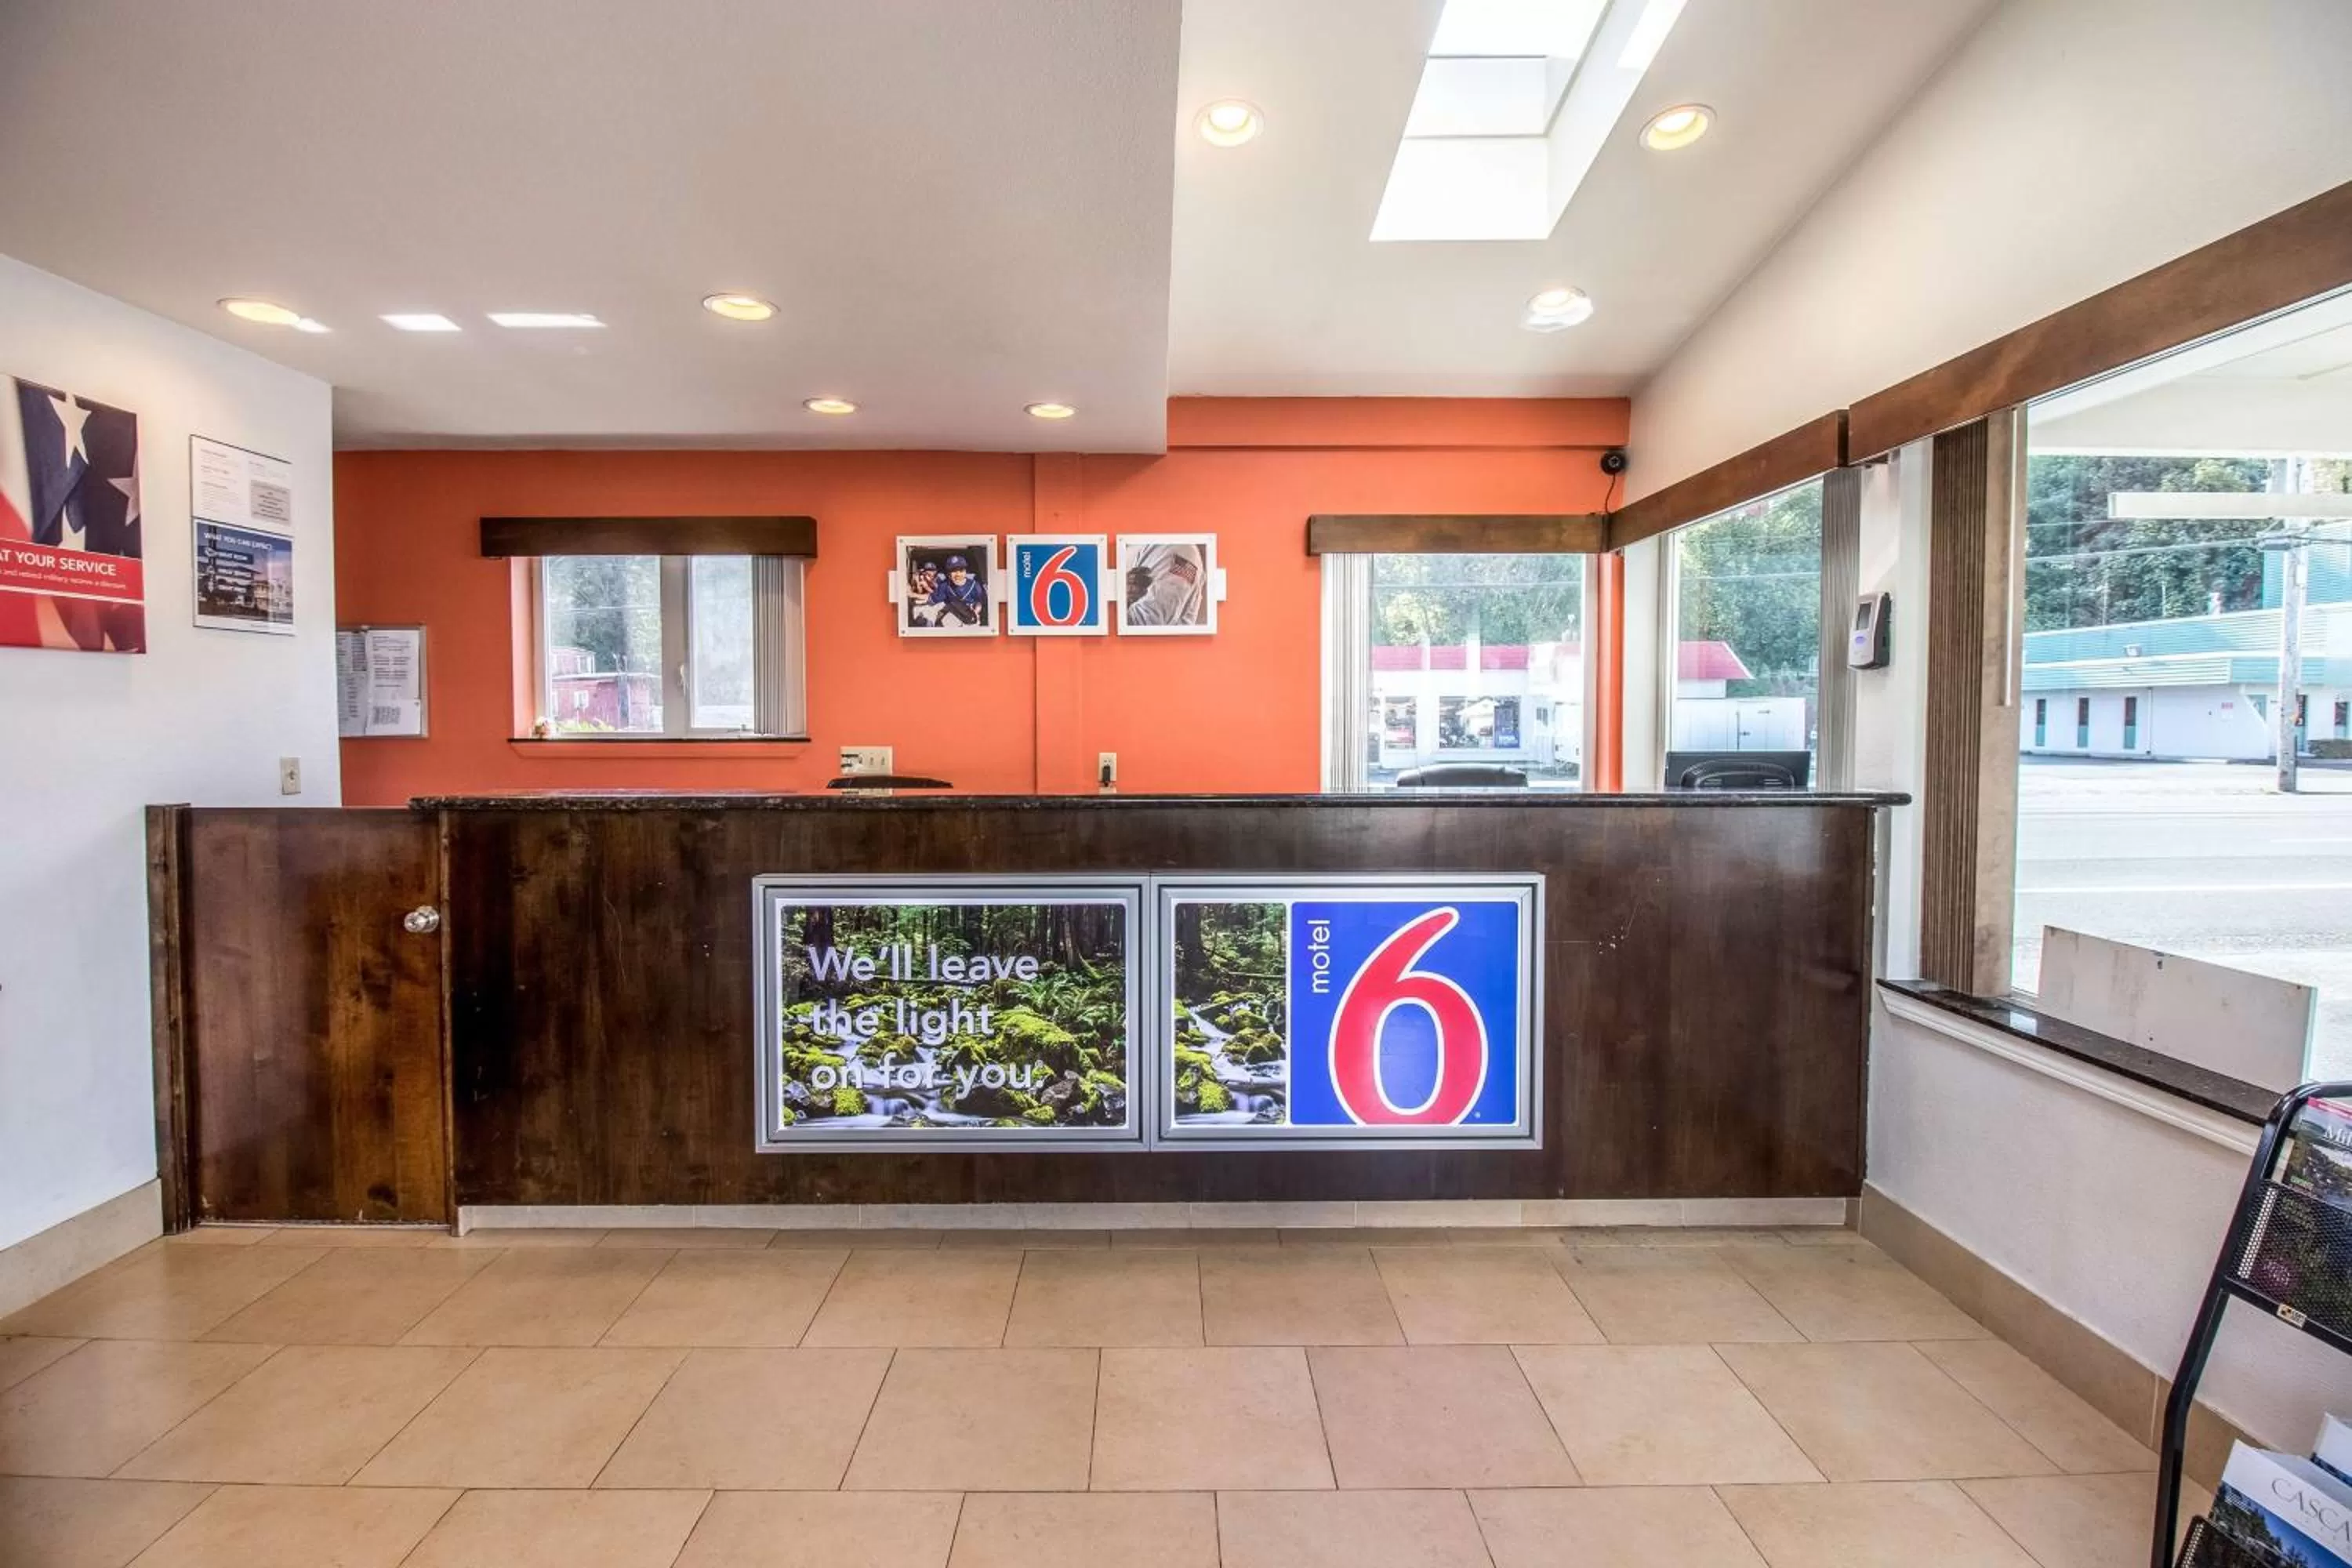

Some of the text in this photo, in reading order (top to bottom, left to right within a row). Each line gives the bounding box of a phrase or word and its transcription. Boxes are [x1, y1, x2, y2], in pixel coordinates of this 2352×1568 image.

[15, 551, 56, 569] YOUR
[60, 557, 117, 576] SERVICE
[1022, 546, 1088, 626] motel 6
[808, 944, 1039, 982] We'll leave
[812, 998, 995, 1046] the light
[1307, 906, 1489, 1127] motel 6
[811, 1052, 1044, 1098] on for you.
